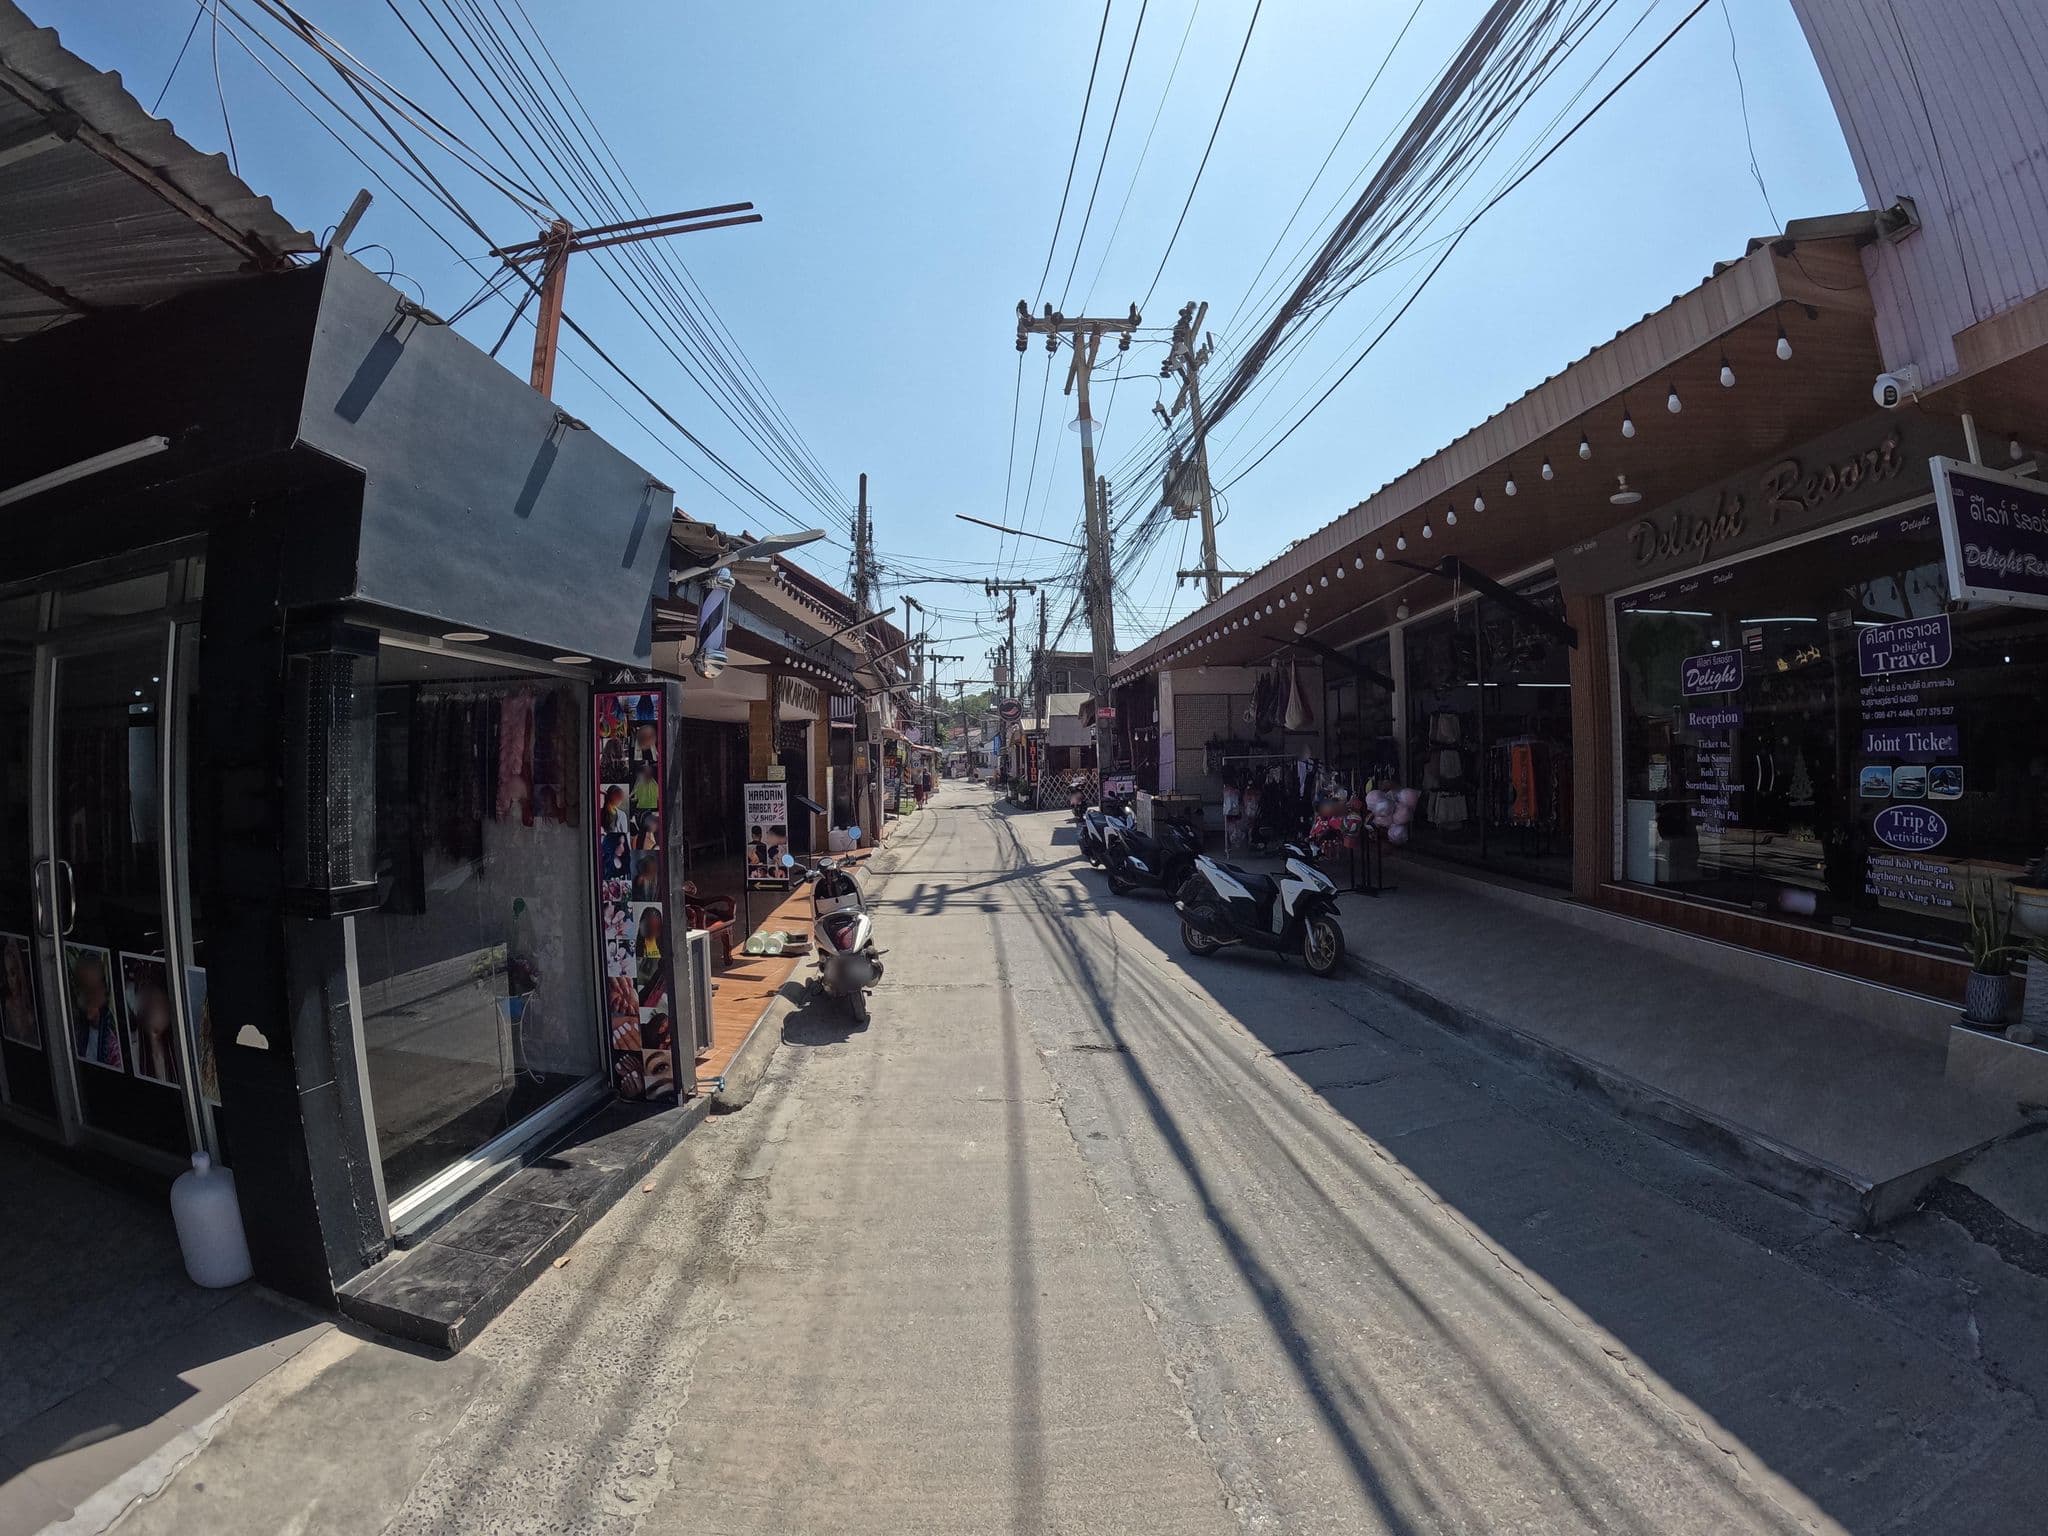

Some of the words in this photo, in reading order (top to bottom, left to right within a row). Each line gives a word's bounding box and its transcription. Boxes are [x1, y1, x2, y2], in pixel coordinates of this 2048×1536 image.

[1627, 491, 1745, 564] Delight
[1765, 439, 1902, 525] Resort
[1900, 515, 1930, 533] Delight
[1850, 530, 1878, 546] Delight
[1963, 543, 2024, 578] Delight
[1866, 624, 1896, 645] ดีไลท์
[1898, 622, 1941, 639] ทราเวล
[1891, 639, 1928, 654] Delight
[1873, 645, 1938, 670] Travel
[1686, 664, 1736, 690] Delight
[1689, 711, 1739, 728] Reception
[1867, 734, 1900, 752] Joint
[1720, 782, 1746, 794] Airport
[1700, 795, 1729, 806] Bangkok
[1890, 810, 1924, 834] Trip
[1927, 815, 1939, 832] &
[1885, 829, 1935, 845] Activities
[1866, 856, 1894, 867] Around
[1895, 859, 1912, 870] Koh
[1912, 862, 1949, 875] Phangan
[1866, 869, 1904, 885] Angthong
[1904, 876, 1934, 888] Marine
[1935, 880, 1956, 891] Park
[1865, 884, 1882, 895] Koh
[1883, 886, 1897, 897] Tao
[1899, 890, 1906, 899] &
[1907, 892, 1929, 904] Nang
